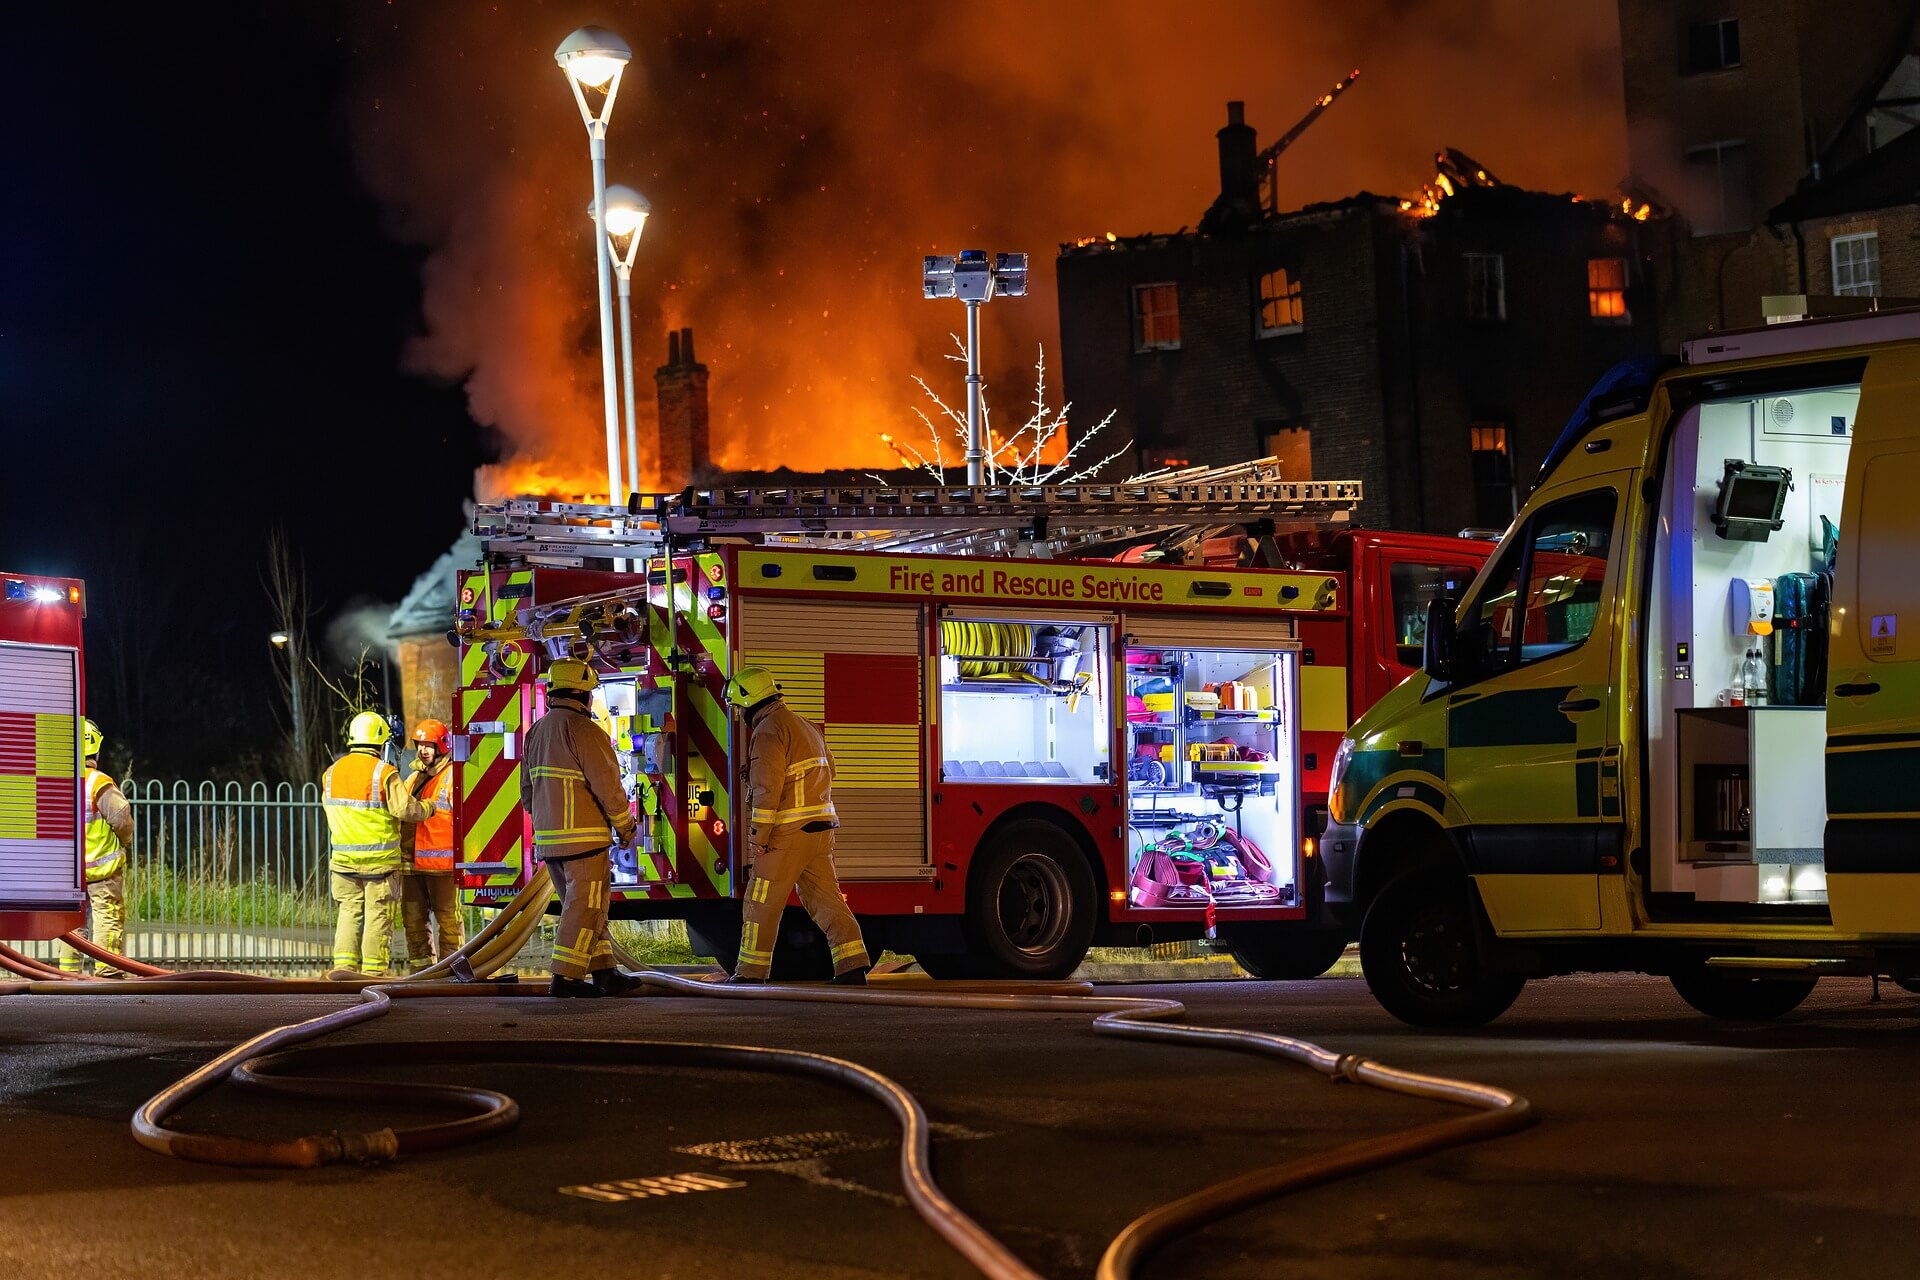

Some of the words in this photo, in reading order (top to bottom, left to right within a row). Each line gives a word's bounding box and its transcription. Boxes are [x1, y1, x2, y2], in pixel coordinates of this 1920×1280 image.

[889, 566, 935, 592] Fire
[941, 569, 985, 594] and
[993, 571, 1075, 597] Rescue
[1081, 575, 1164, 601] Service
[1198, 938, 1227, 946] SCANIA
